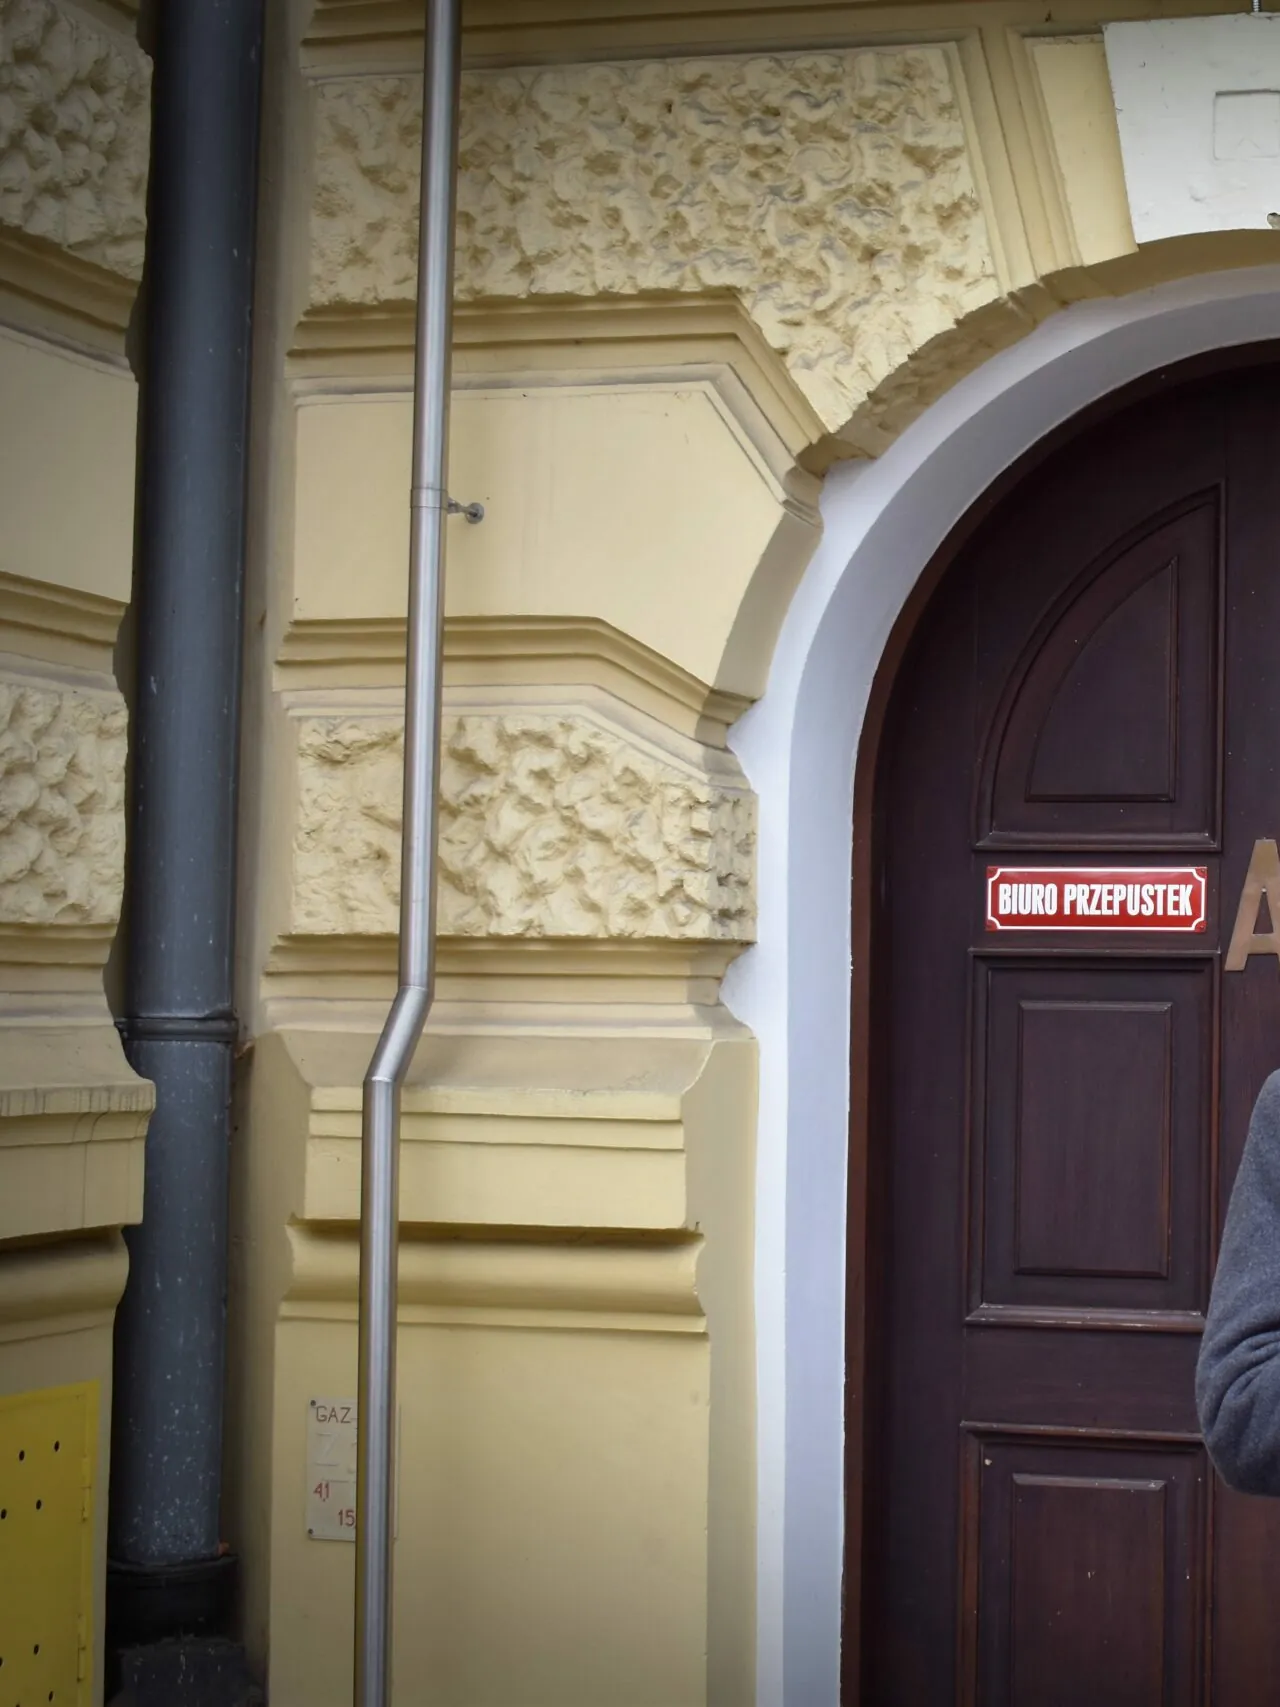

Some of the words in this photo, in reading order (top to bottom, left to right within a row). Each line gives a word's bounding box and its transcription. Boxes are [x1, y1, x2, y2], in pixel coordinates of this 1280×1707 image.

[998, 883, 1058, 916] BIURO
[1063, 883, 1194, 917] PRZEPUSTEK
[316, 1405, 352, 1424] GAZ
